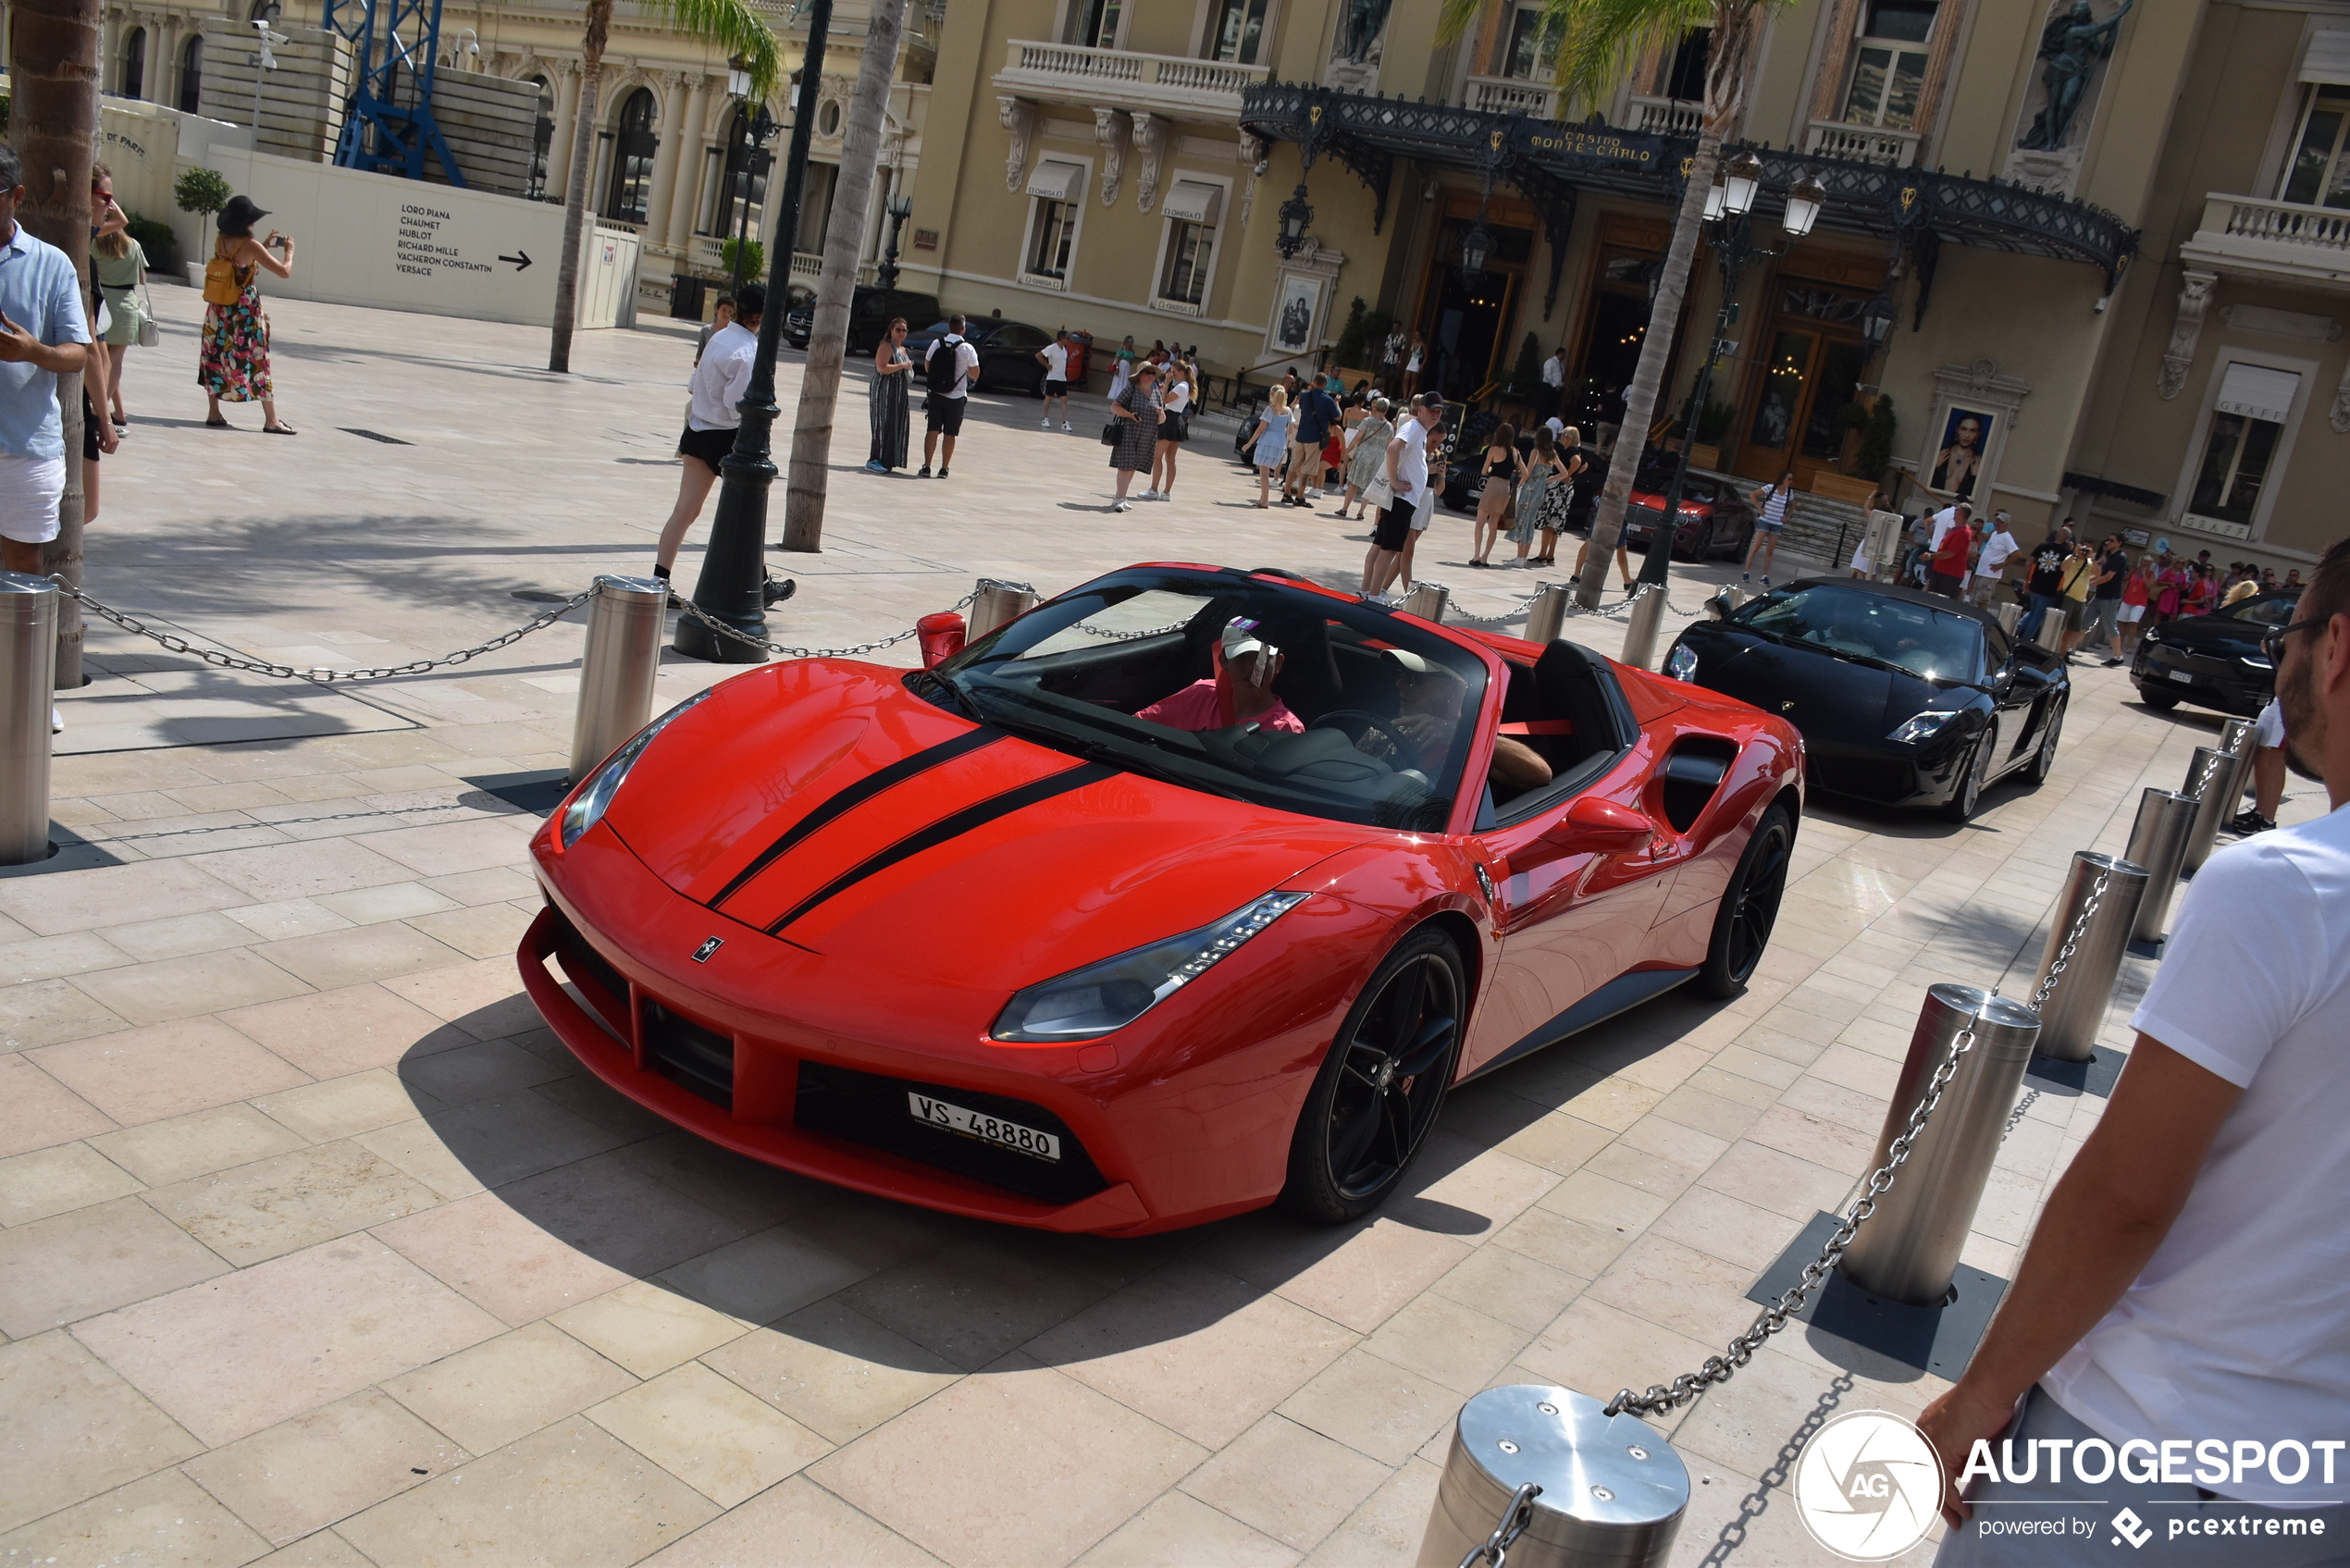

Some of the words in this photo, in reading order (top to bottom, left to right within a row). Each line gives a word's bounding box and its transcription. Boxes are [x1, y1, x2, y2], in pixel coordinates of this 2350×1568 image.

[107, 132, 118, 142] DE
[120, 136, 146, 157] PARIS
[1565, 131, 1620, 146] CASINO
[1034, 188, 1056, 197] OMEGA
[402, 204, 425, 216] LORO
[427, 208, 451, 220] PIANA
[1170, 209, 1194, 219] OMEGA
[401, 216, 440, 229] CHAUMET
[399, 228, 432, 241] HUBLOT
[398, 241, 434, 253] RICHARD
[435, 246, 459, 256] MILLE
[397, 252, 441, 265] VACHERON
[442, 258, 492, 273] CONSTANTIN
[396, 264, 432, 276] VERSACE
[1032, 278, 1052, 287] OMEGA
[1166, 303, 1188, 314] OMEGA
[2220, 401, 2281, 420] GRAFF
[2185, 517, 2245, 537] GRAFF
